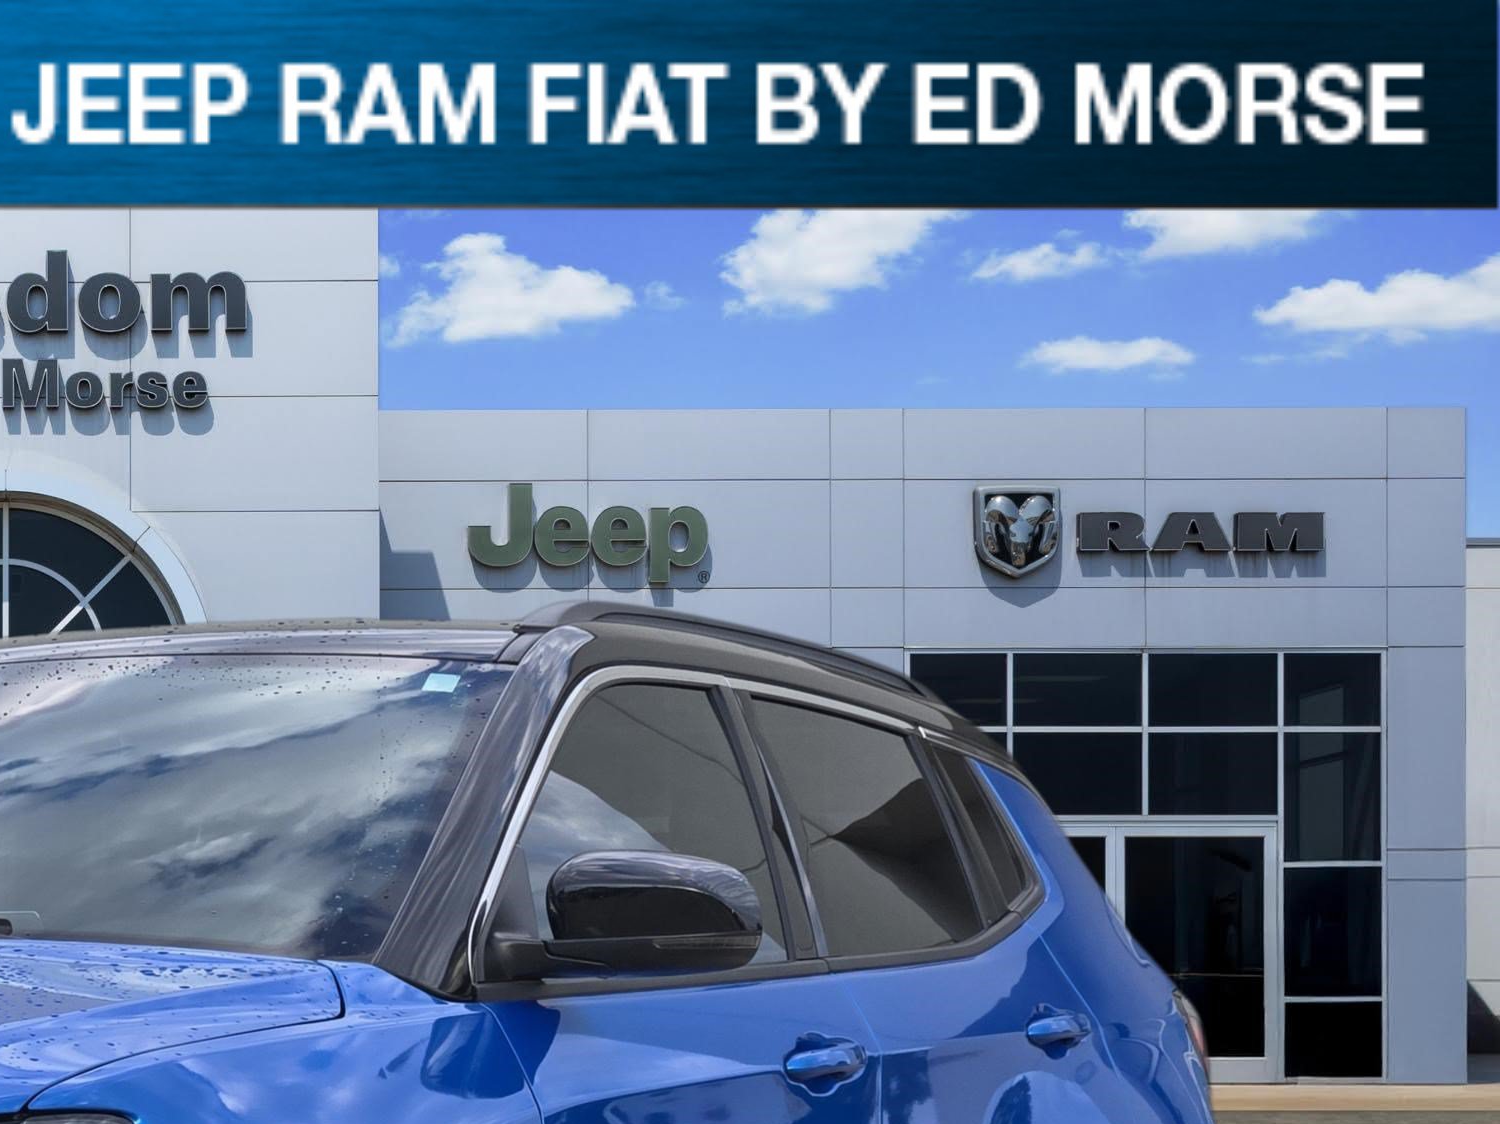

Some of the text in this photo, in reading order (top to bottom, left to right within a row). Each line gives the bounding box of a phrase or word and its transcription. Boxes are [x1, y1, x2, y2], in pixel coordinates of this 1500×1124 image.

[2, 358, 209, 409] Morse
[466, 482, 709, 583] Jeep
[1076, 511, 1325, 553] RAM
